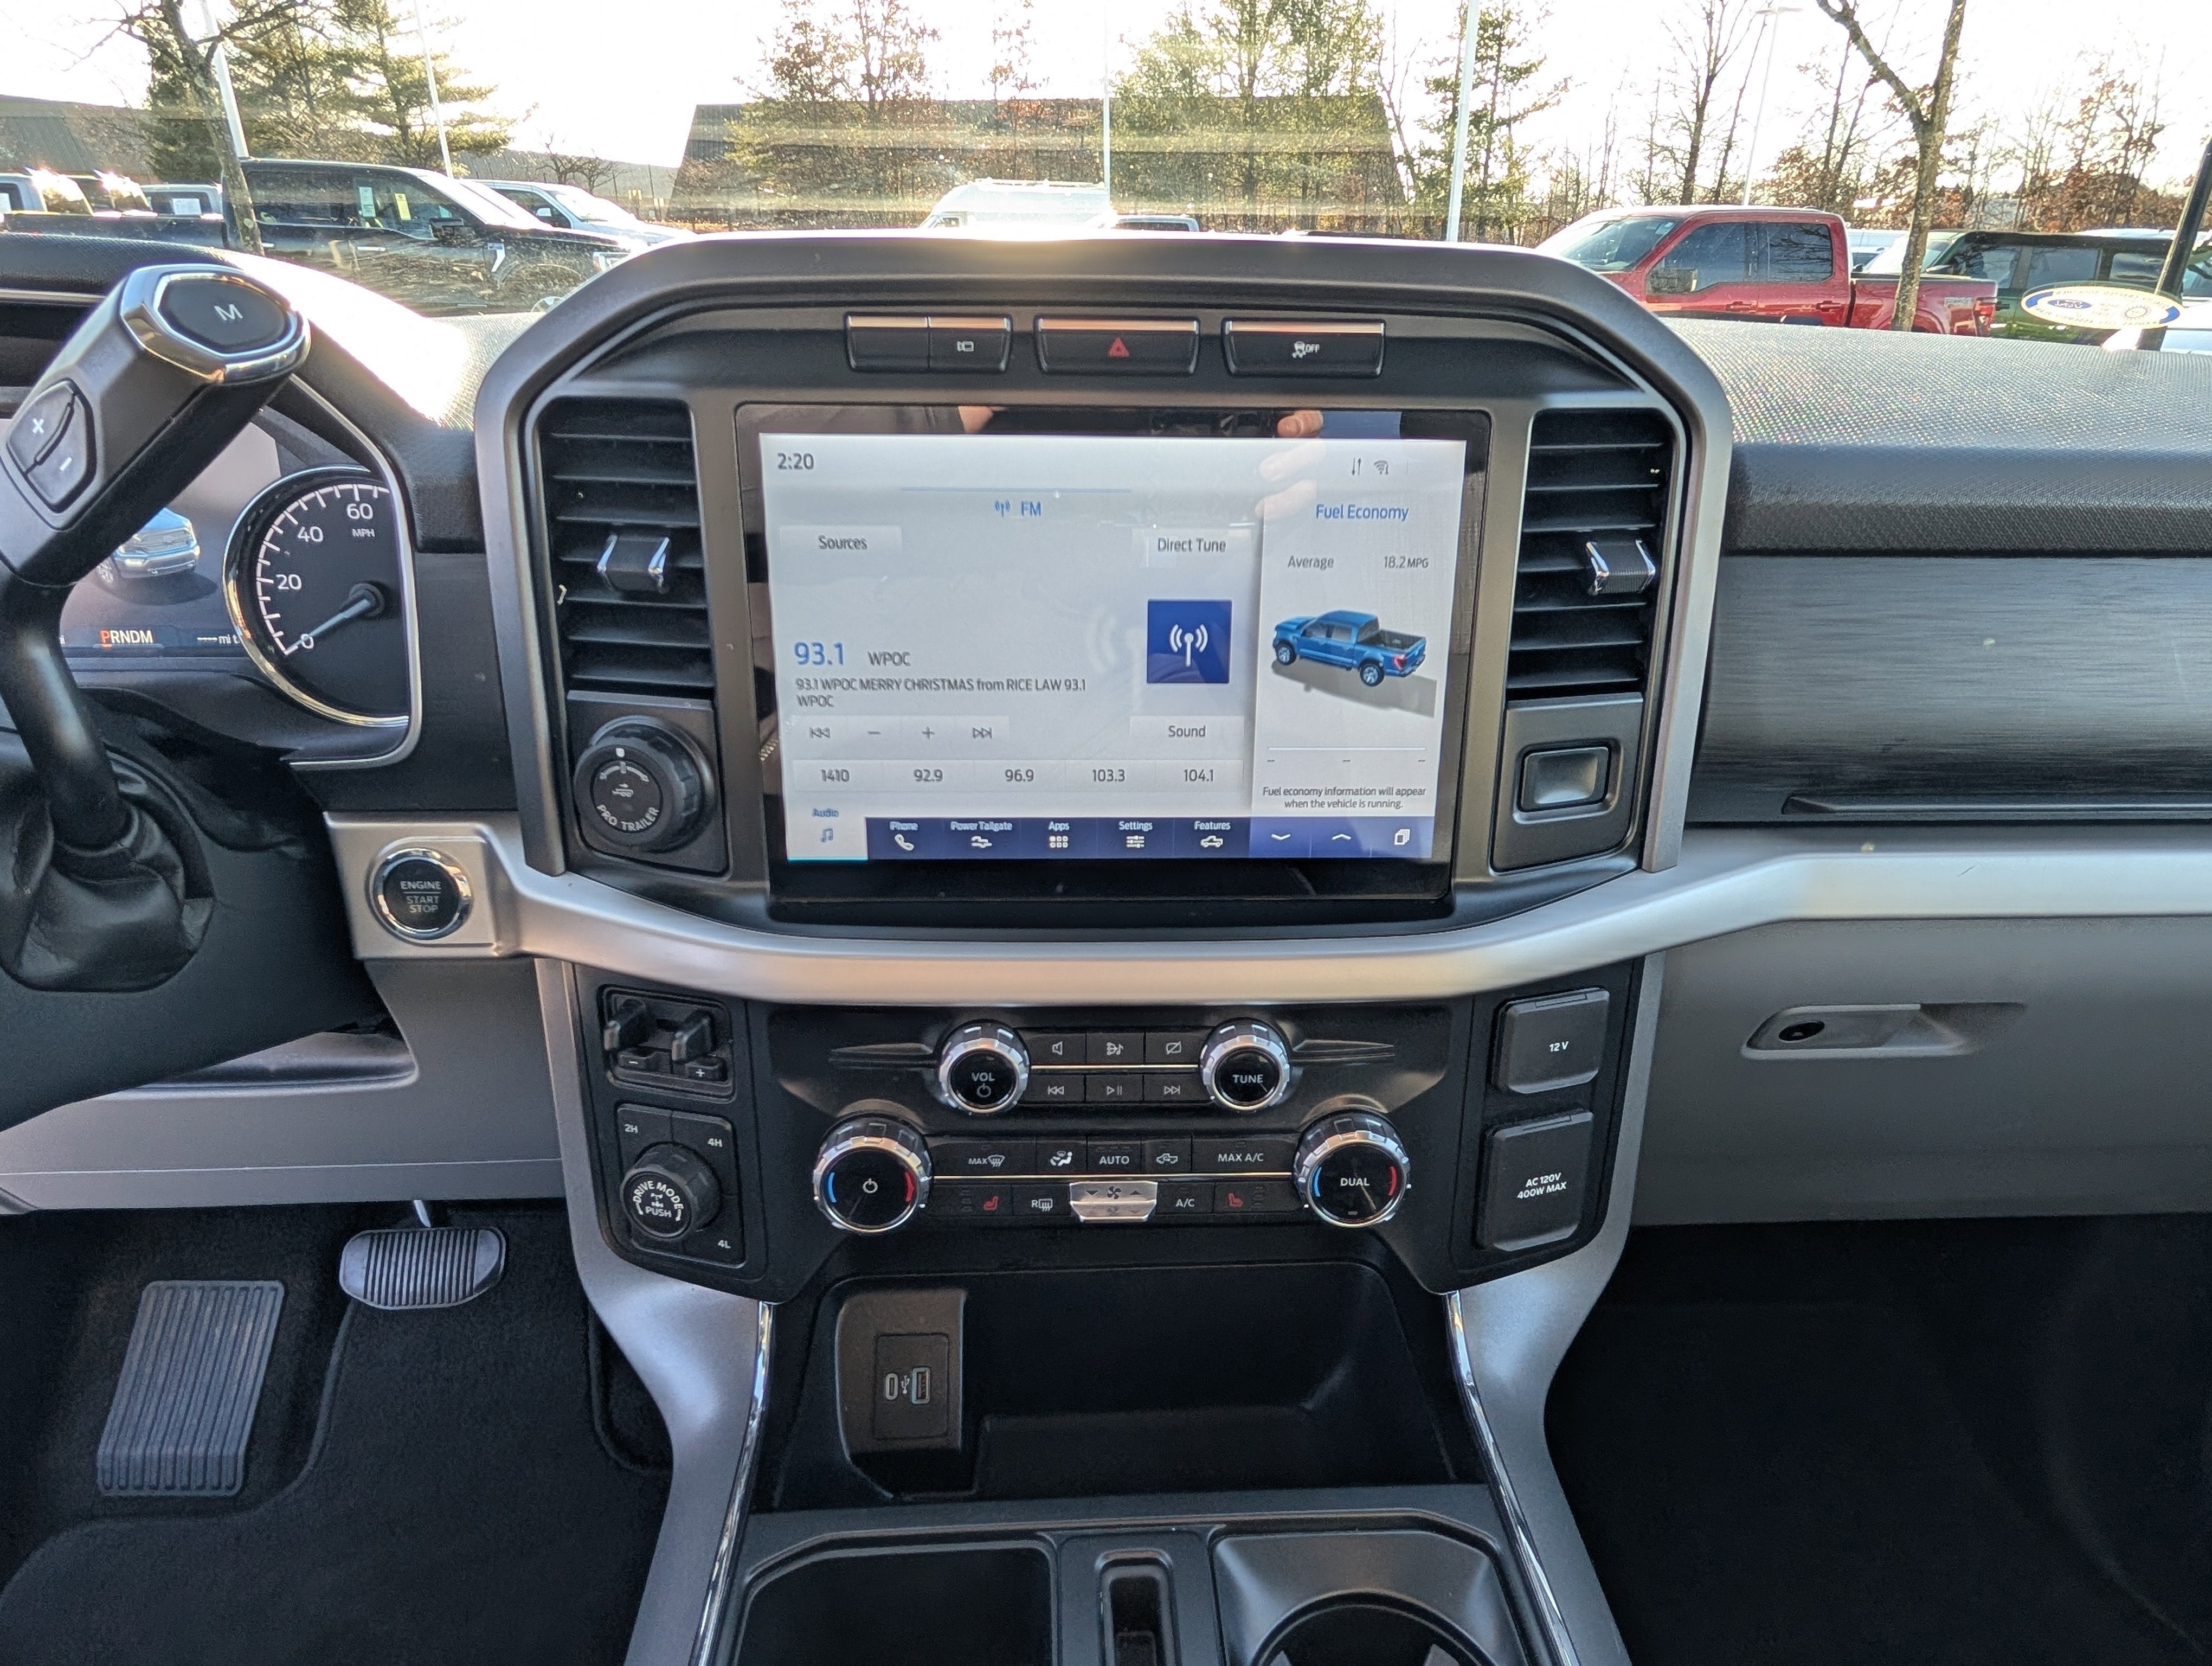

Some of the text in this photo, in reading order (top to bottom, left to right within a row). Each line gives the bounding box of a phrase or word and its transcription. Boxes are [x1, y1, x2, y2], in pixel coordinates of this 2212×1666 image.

[214, 304, 243, 321] M
[1306, 343, 1320, 353] OFF
[777, 453, 814, 470] 2:20
[346, 503, 374, 520] 60
[1021, 501, 1041, 516] FM
[1316, 504, 1409, 522] Fuel Economy
[297, 526, 324, 542] 40
[352, 528, 375, 538] MPH
[818, 535, 867, 550] Sources
[1158, 537, 1226, 552] Direct Tune
[1288, 555, 1334, 571] Average
[277, 574, 302, 591] 20
[300, 634, 314, 649] 0
[794, 642, 844, 666] 93.1
[868, 652, 911, 667] WPOC
[795, 678, 1086, 692] 93.1 WPOC MERRY CHRISTMAS from RICE LAW 93.1
[798, 695, 834, 707] WPOC
[1168, 725, 1206, 738] Sound
[821, 770, 850, 782] 1410
[914, 770, 943, 782] 92.9
[1005, 770, 1034, 782] 96.9
[1092, 770, 1126, 783] 103.3
[1184, 770, 1214, 782] 104.1
[1263, 786, 1426, 798] Fuel economy information will appear
[1285, 799, 1403, 810] when the vehicle is running.
[596, 804, 659, 831] PRO TRAILER
[813, 809, 839, 818] Audio
[890, 821, 918, 831] Phone
[951, 821, 1012, 832] Power Tailgate
[1049, 821, 1069, 832] Apps
[1119, 821, 1153, 832] Settings
[1194, 821, 1231, 831] Features
[400, 881, 441, 890] ENGINE
[406, 895, 439, 905] START
[410, 904, 438, 913] STOP
[1549, 1041, 1569, 1052] 12 V
[972, 1073, 995, 1082] VOL
[1233, 1074, 1263, 1084] TUNE
[625, 1124, 638, 1133] 2H
[708, 1138, 723, 1148] 4H
[968, 1157, 987, 1165] MAX
[1099, 1156, 1130, 1165] AUTO
[1218, 1153, 1264, 1162] MAX A/C
[1340, 1177, 1369, 1187] DUAL
[1526, 1172, 1562, 1188] AC 120V
[633, 1181, 684, 1209] DRIVE MODE
[1517, 1181, 1567, 1199] 400W MAX
[1032, 1200, 1038, 1208] R
[1175, 1199, 1195, 1208] A/C
[645, 1206, 672, 1218] PUSH
[718, 1239, 731, 1248] 4L
